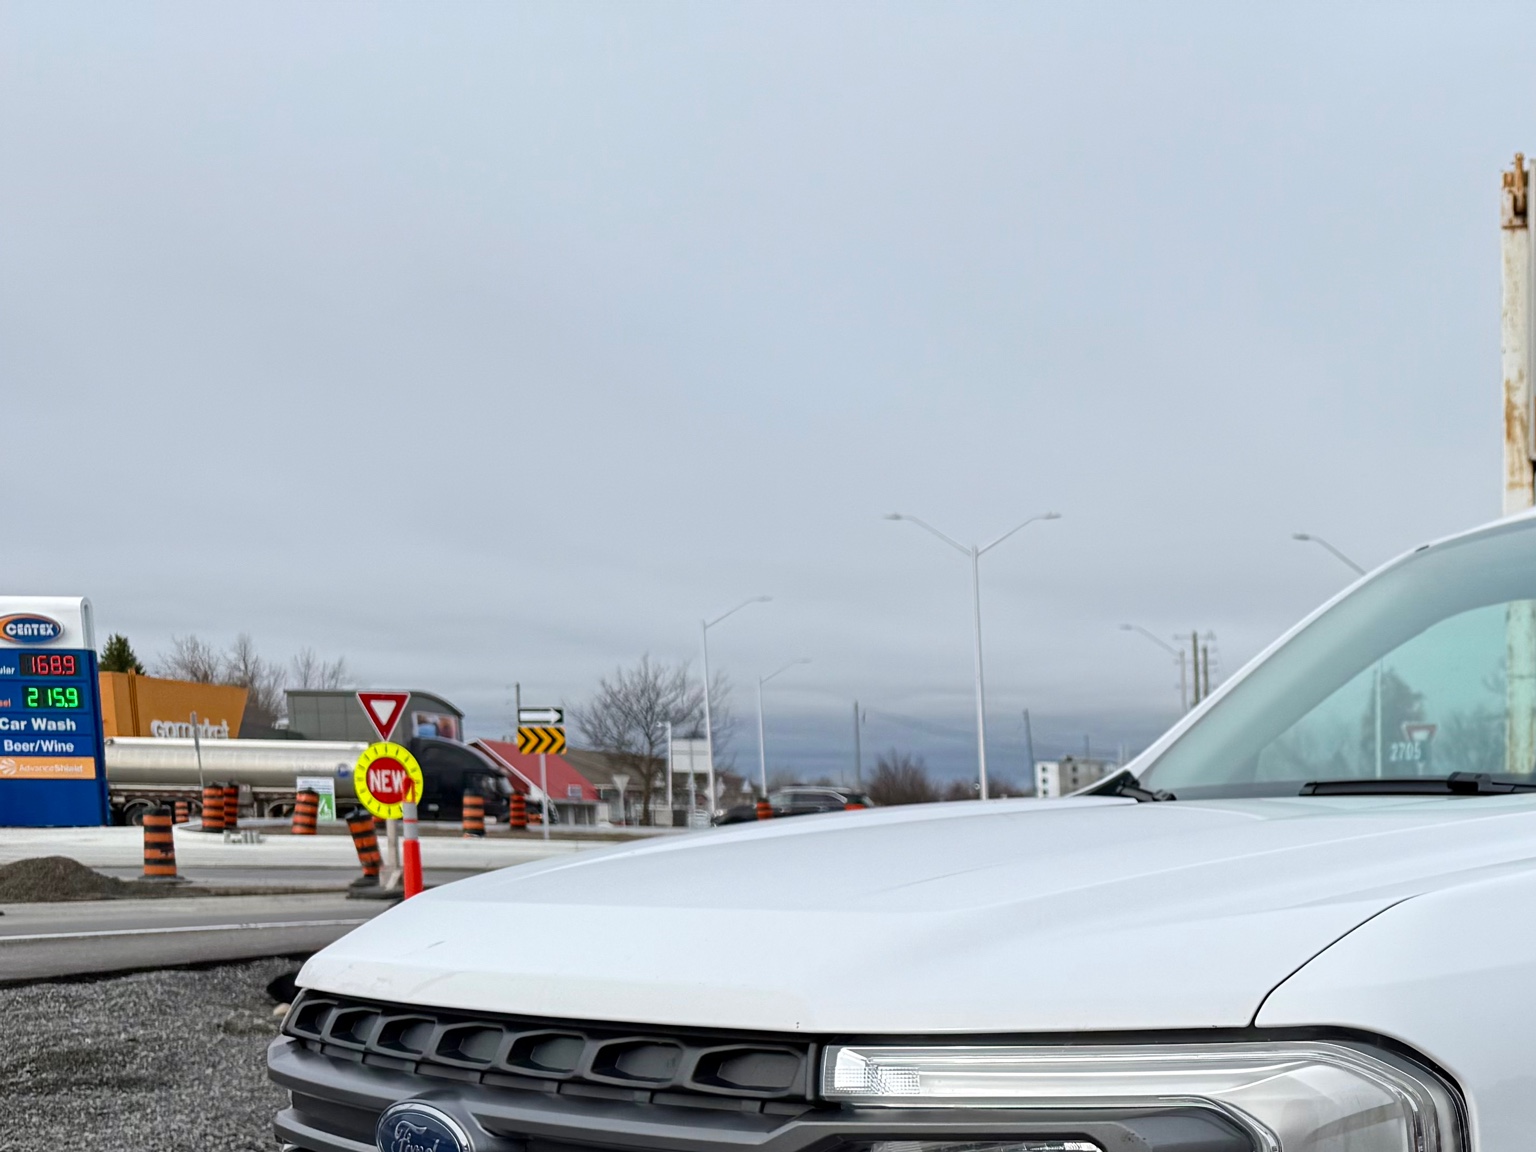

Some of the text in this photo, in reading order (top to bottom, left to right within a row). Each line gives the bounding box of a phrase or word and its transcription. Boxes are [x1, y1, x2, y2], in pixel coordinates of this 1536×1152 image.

[5, 622, 55, 636] CENTEX
[0, 716, 77, 731] Car Wash
[3, 738, 75, 753] Beer/Wine
[1389, 741, 1422, 761] 2705
[369, 768, 406, 793] NEW
